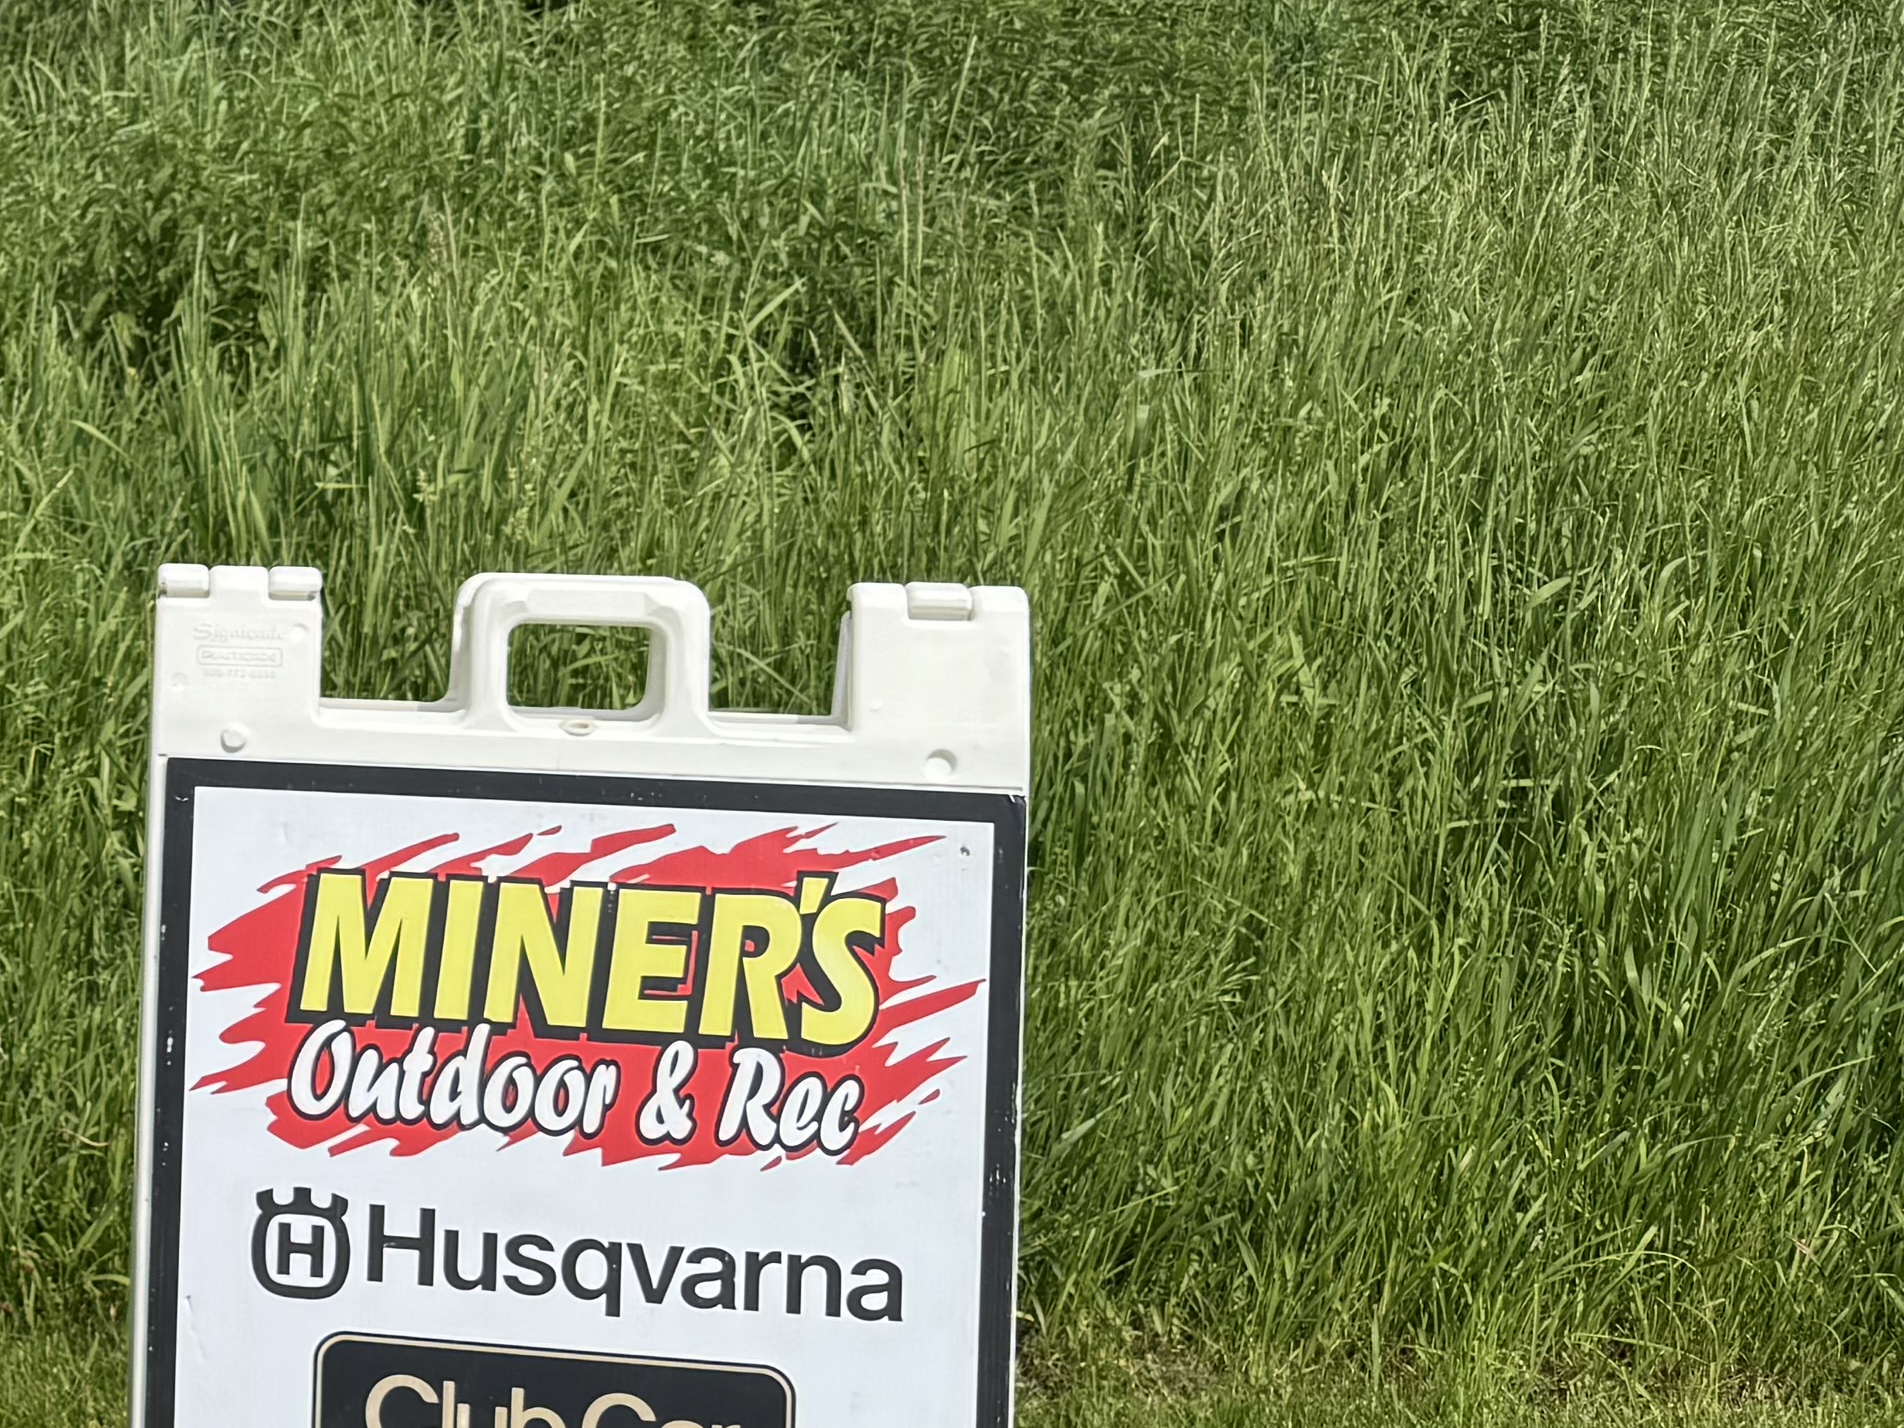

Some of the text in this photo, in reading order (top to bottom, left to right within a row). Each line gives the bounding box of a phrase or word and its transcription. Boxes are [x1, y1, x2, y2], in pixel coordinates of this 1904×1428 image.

[300, 873, 883, 1046] MINER'S
[290, 1020, 860, 1153] Outdoor & Rec
[367, 1204, 903, 1322] Husqvarna
